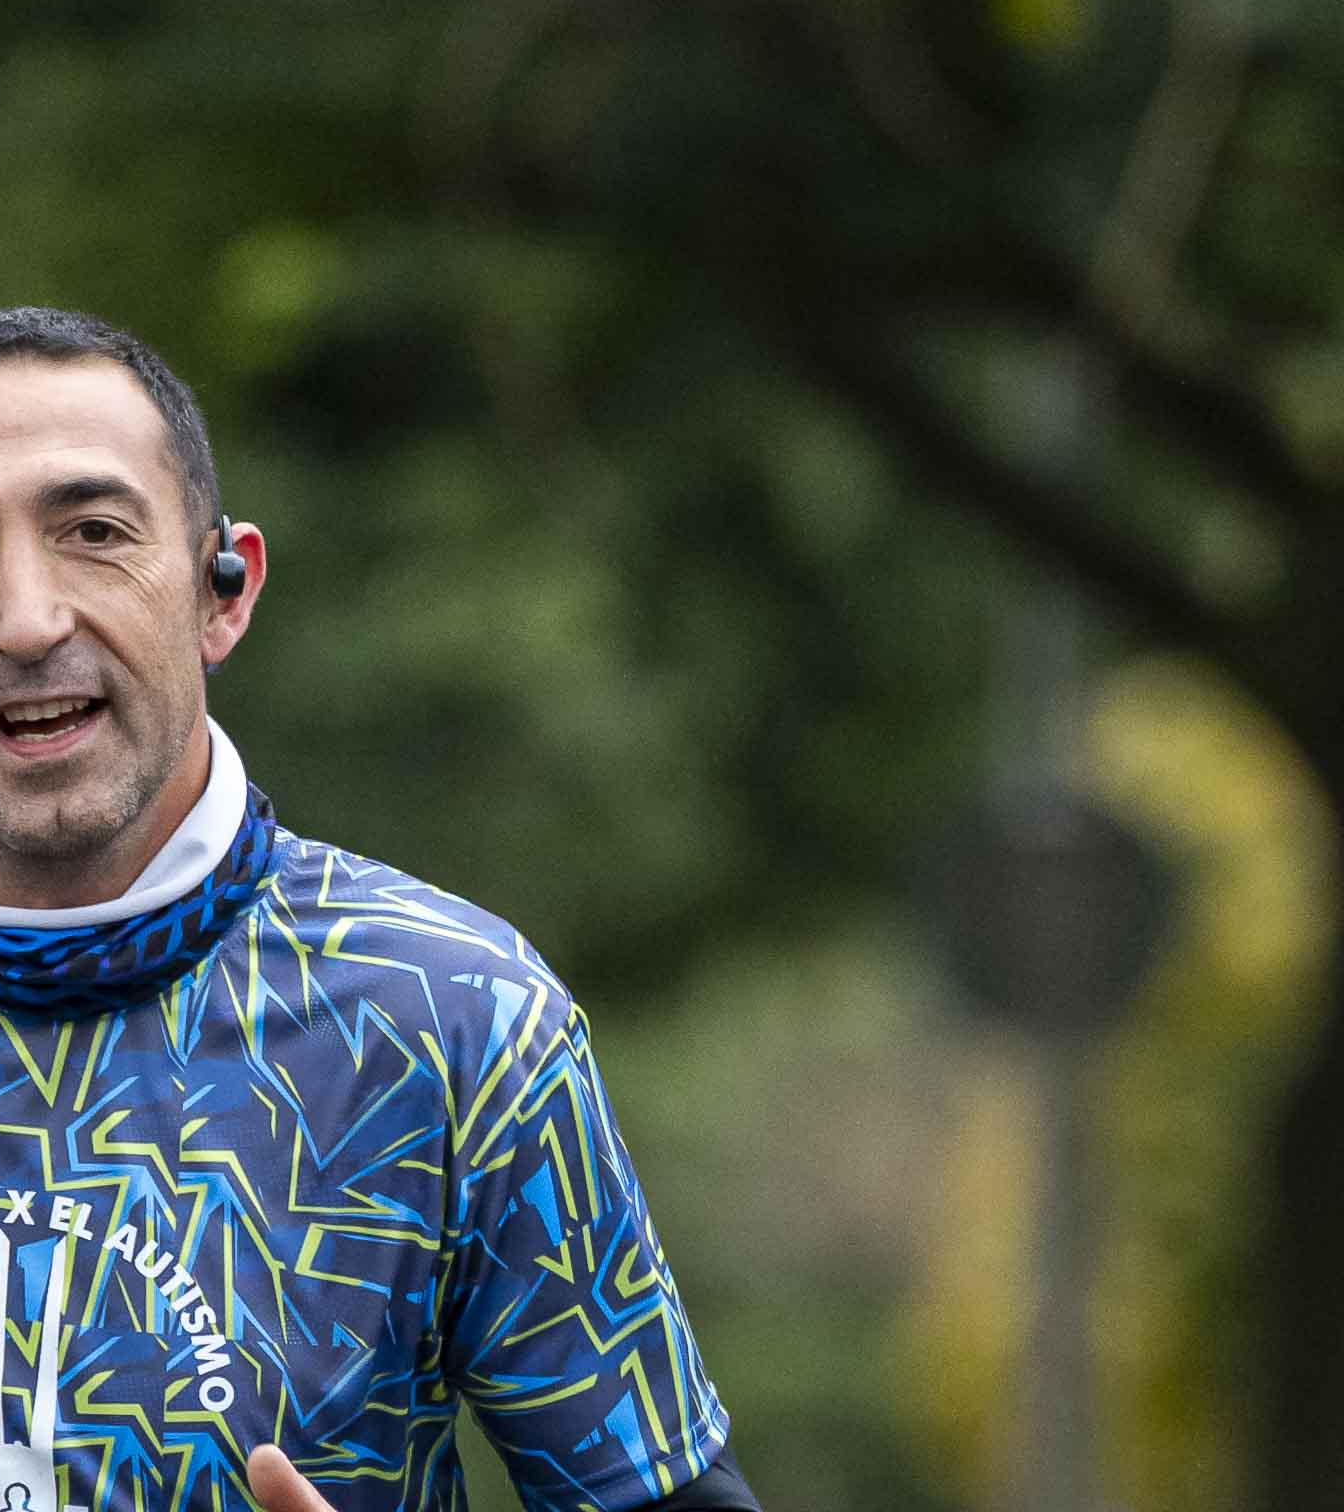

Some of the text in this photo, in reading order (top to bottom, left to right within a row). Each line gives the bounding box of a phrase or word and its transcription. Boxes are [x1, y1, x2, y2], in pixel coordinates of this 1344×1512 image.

[4, 1189, 37, 1226] X
[48, 1194, 95, 1241] EL
[103, 1223, 235, 1412] AUTISMO
